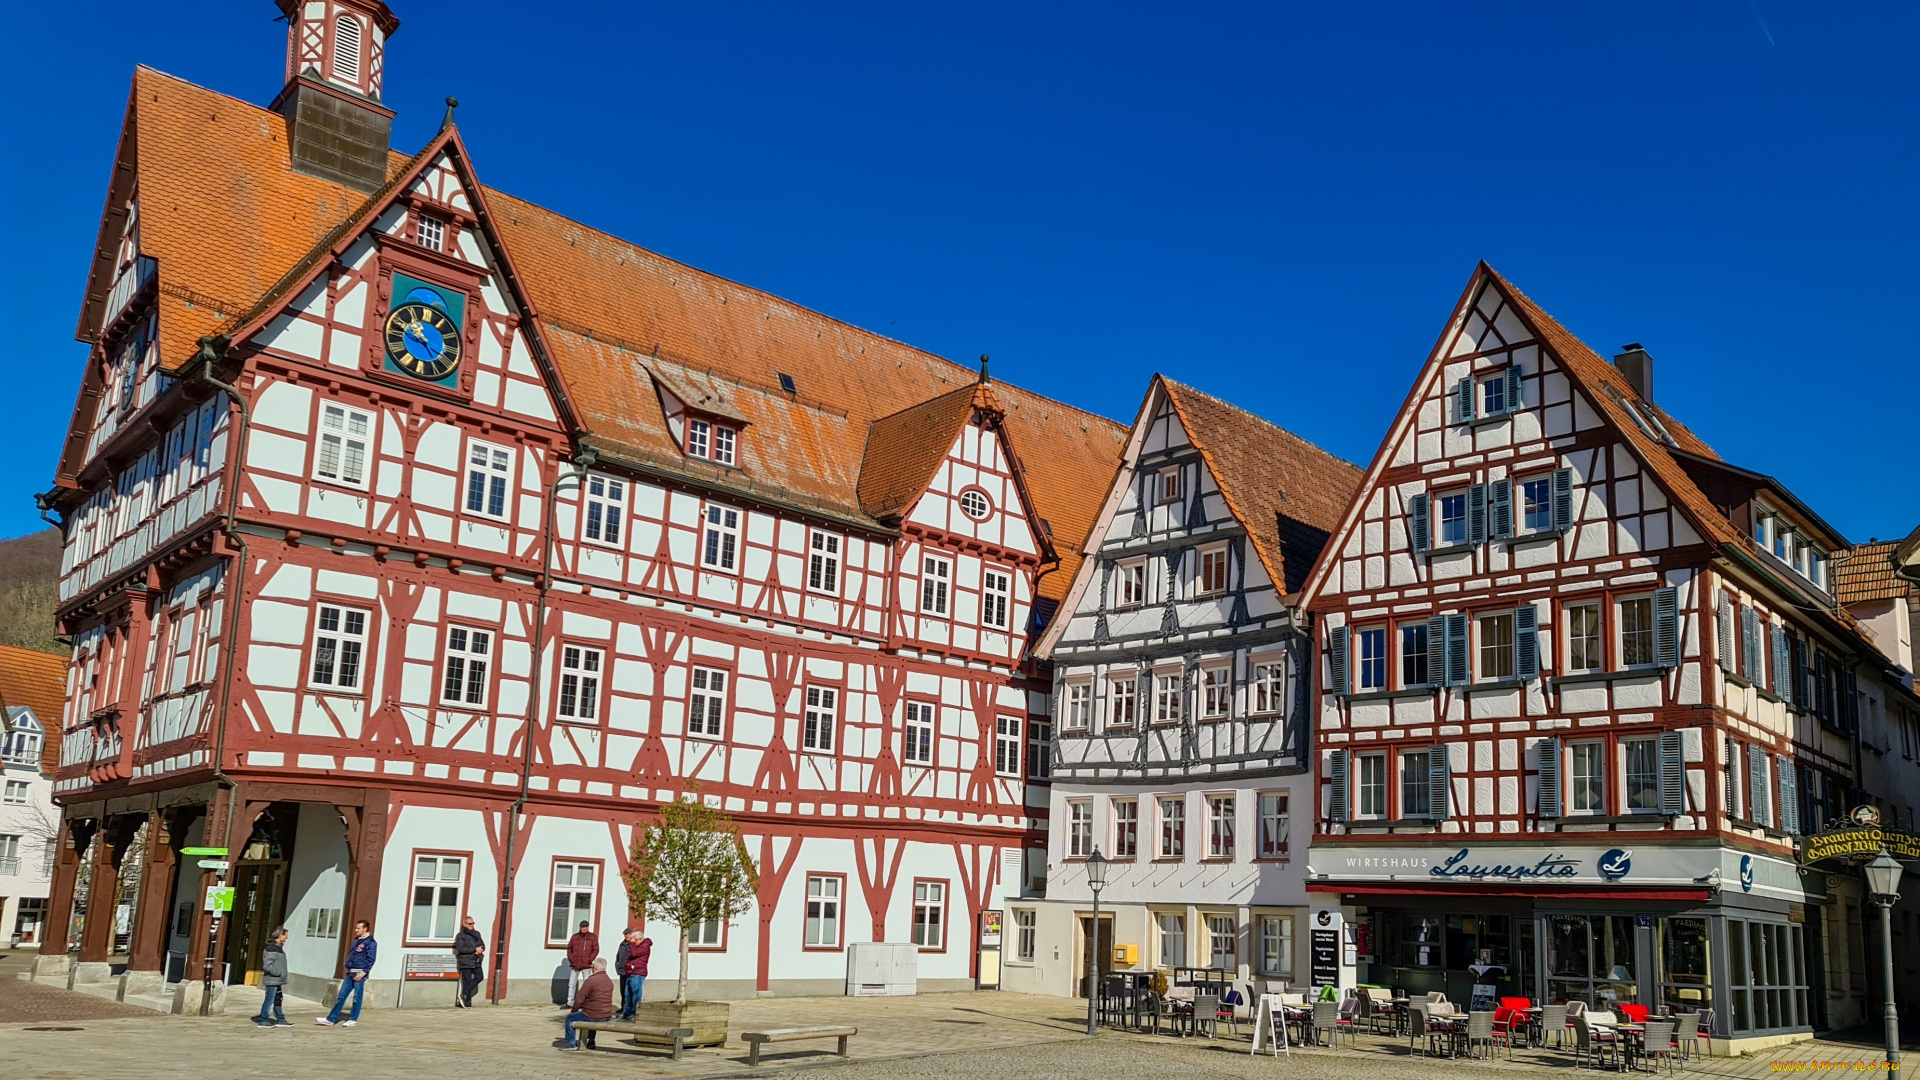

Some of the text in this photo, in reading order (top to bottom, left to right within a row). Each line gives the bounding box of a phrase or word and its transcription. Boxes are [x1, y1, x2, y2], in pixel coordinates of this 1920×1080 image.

[1811, 829, 1920, 847] Brauerei Quenze
[1808, 842, 1852, 859] Gasthof
[1346, 848, 1582, 877] WIRTSHAUS Laurentia
